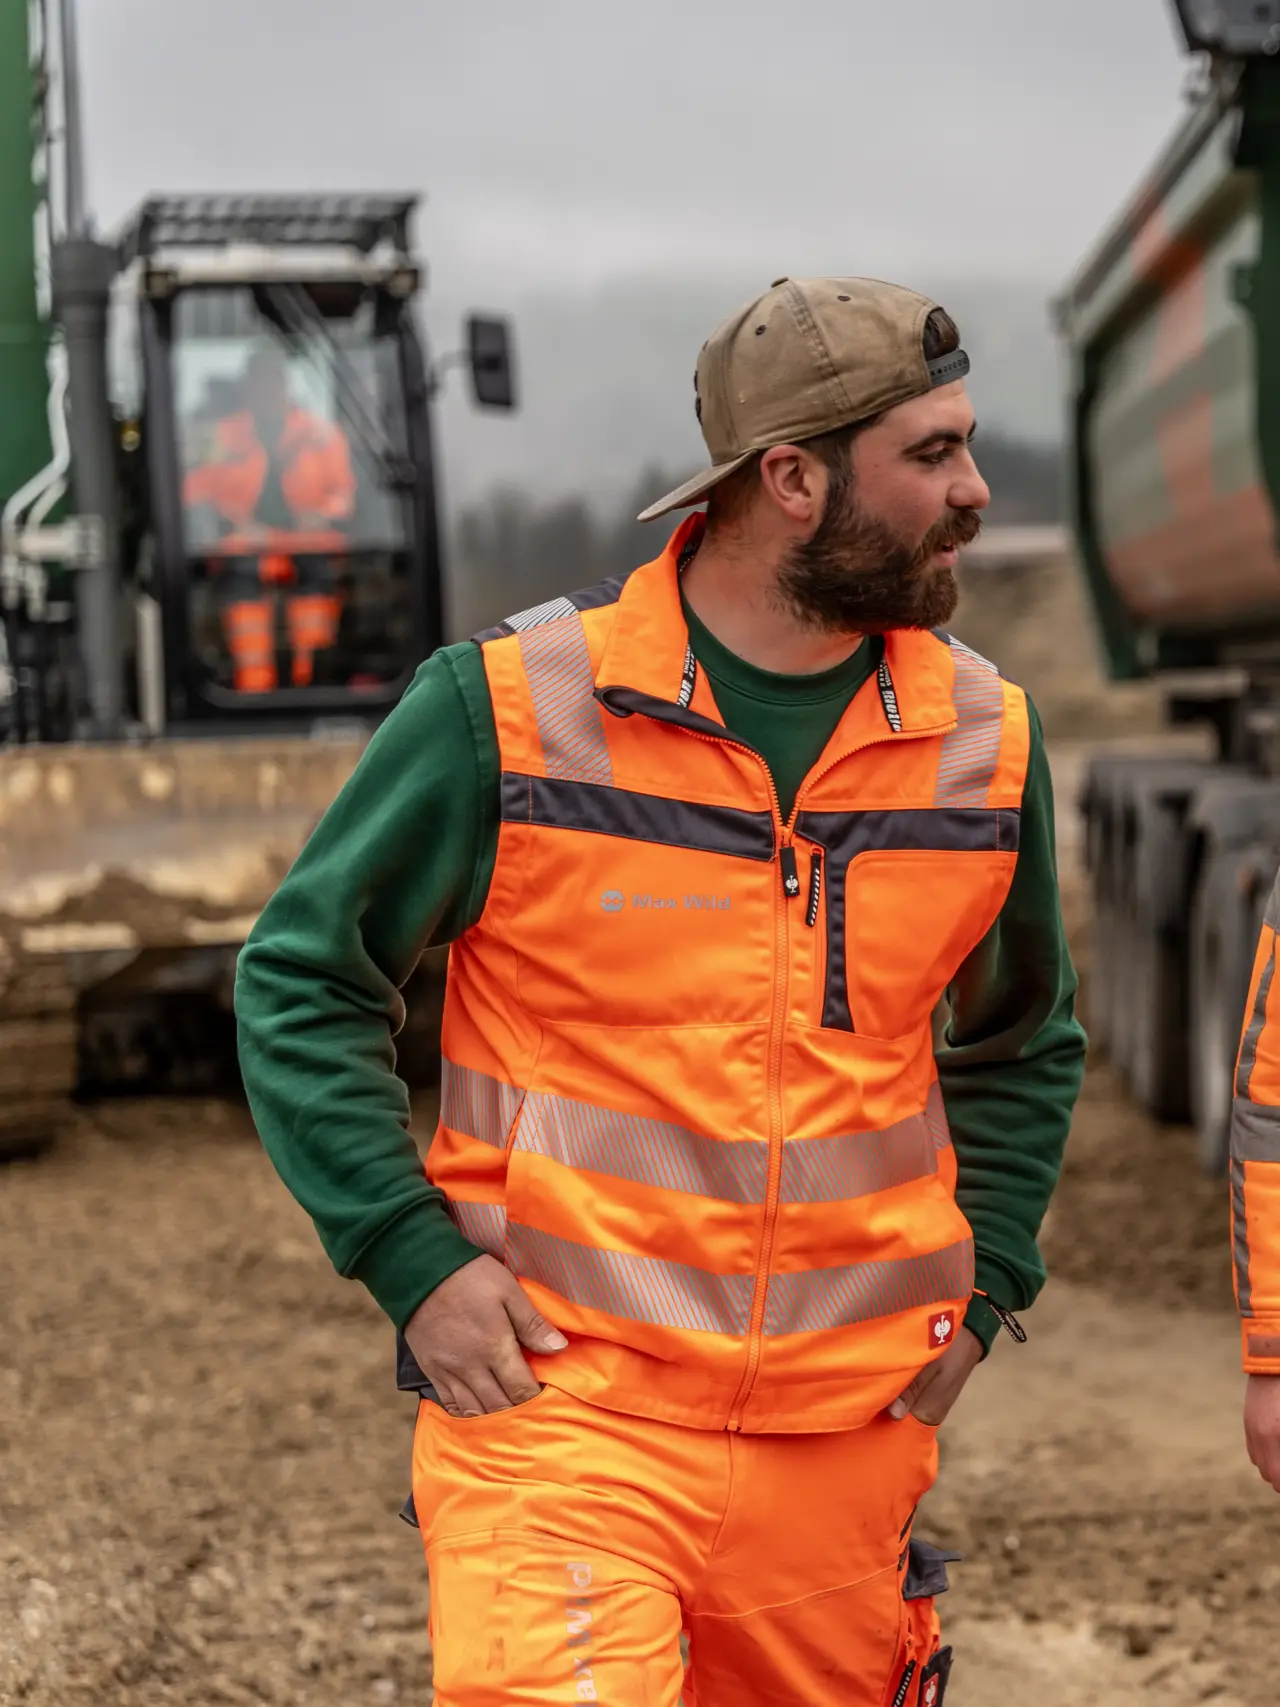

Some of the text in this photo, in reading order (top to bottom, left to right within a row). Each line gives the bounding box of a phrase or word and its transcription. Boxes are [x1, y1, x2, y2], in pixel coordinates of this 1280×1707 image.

[632, 892, 731, 910] Max Wild
[566, 1562, 592, 1647] Wild
